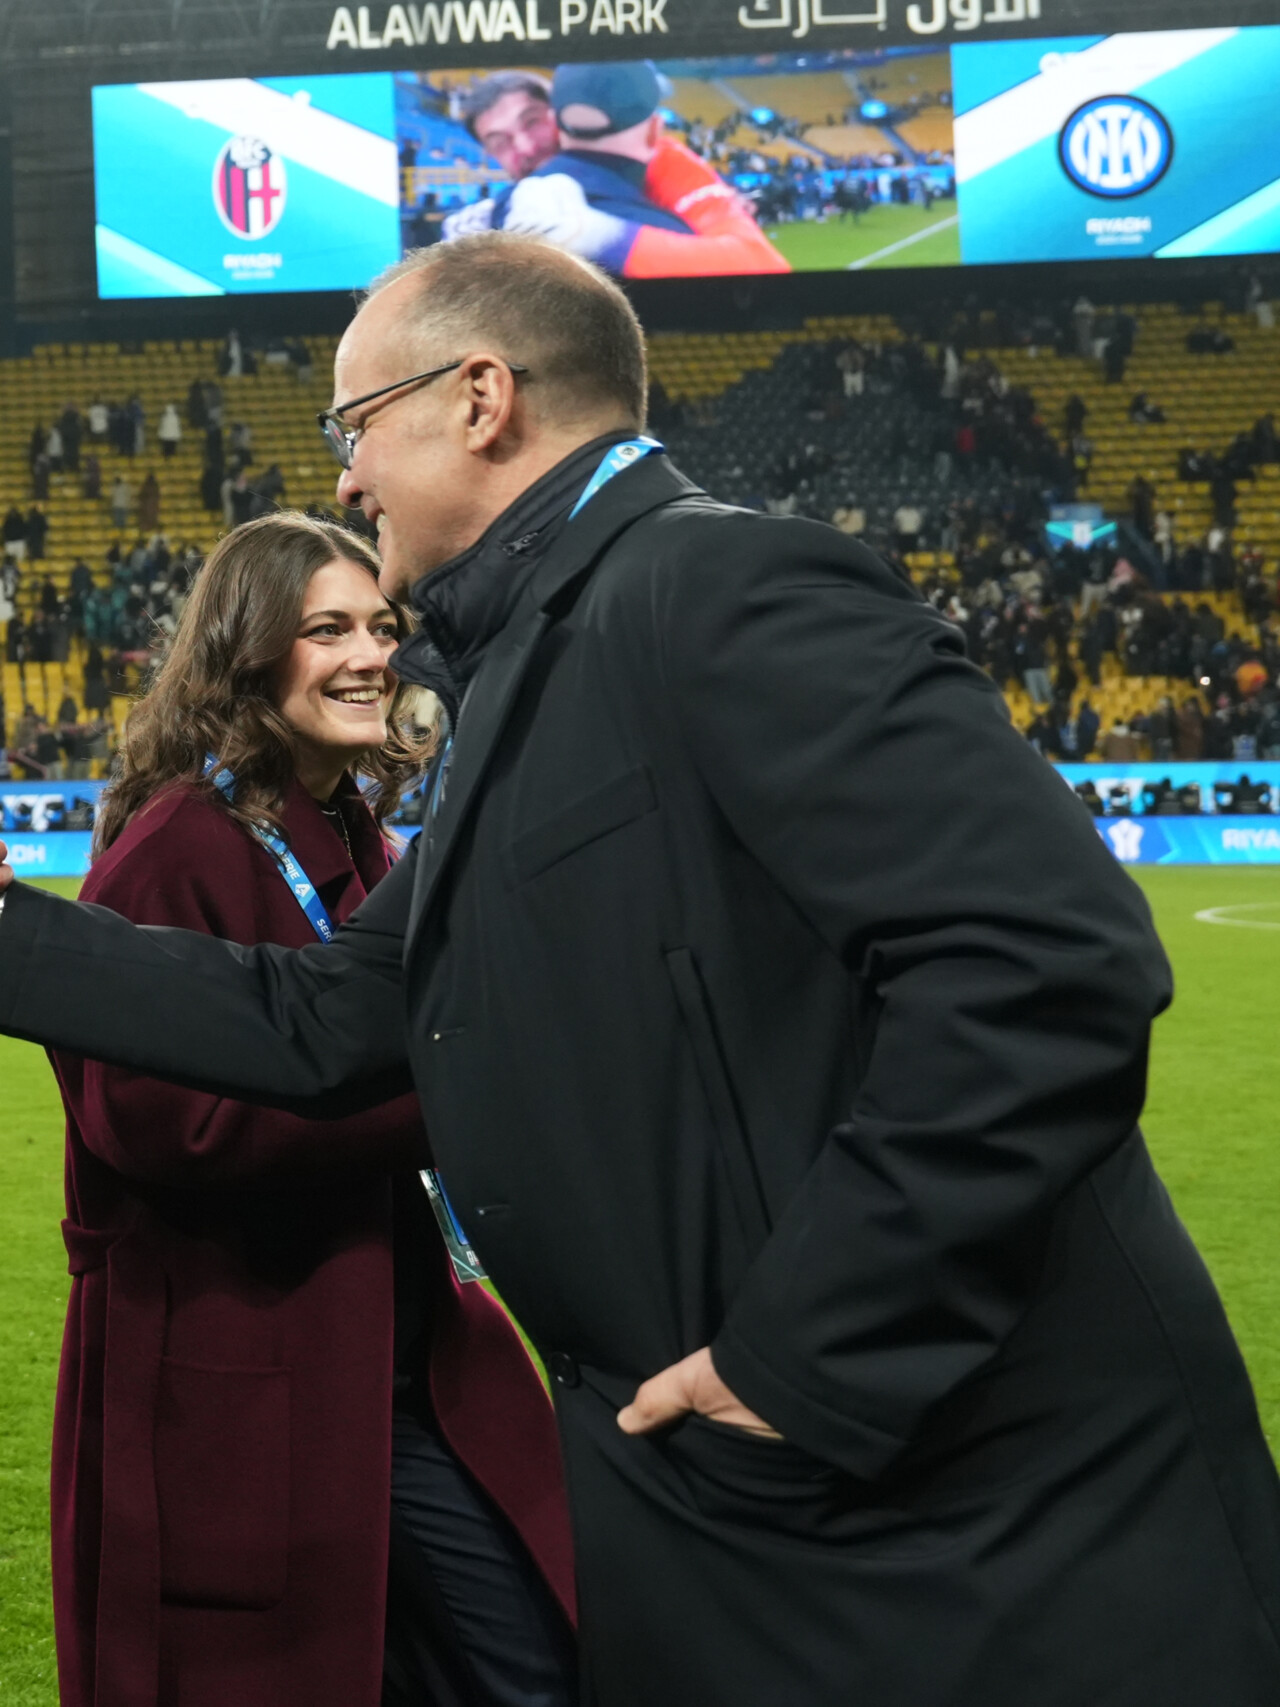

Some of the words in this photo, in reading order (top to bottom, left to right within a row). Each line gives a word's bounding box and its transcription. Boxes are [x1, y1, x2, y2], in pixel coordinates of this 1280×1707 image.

[327, 1, 552, 49] ALAWWAL
[560, 0, 669, 36] PARK
[1222, 828, 1280, 850] RIYA
